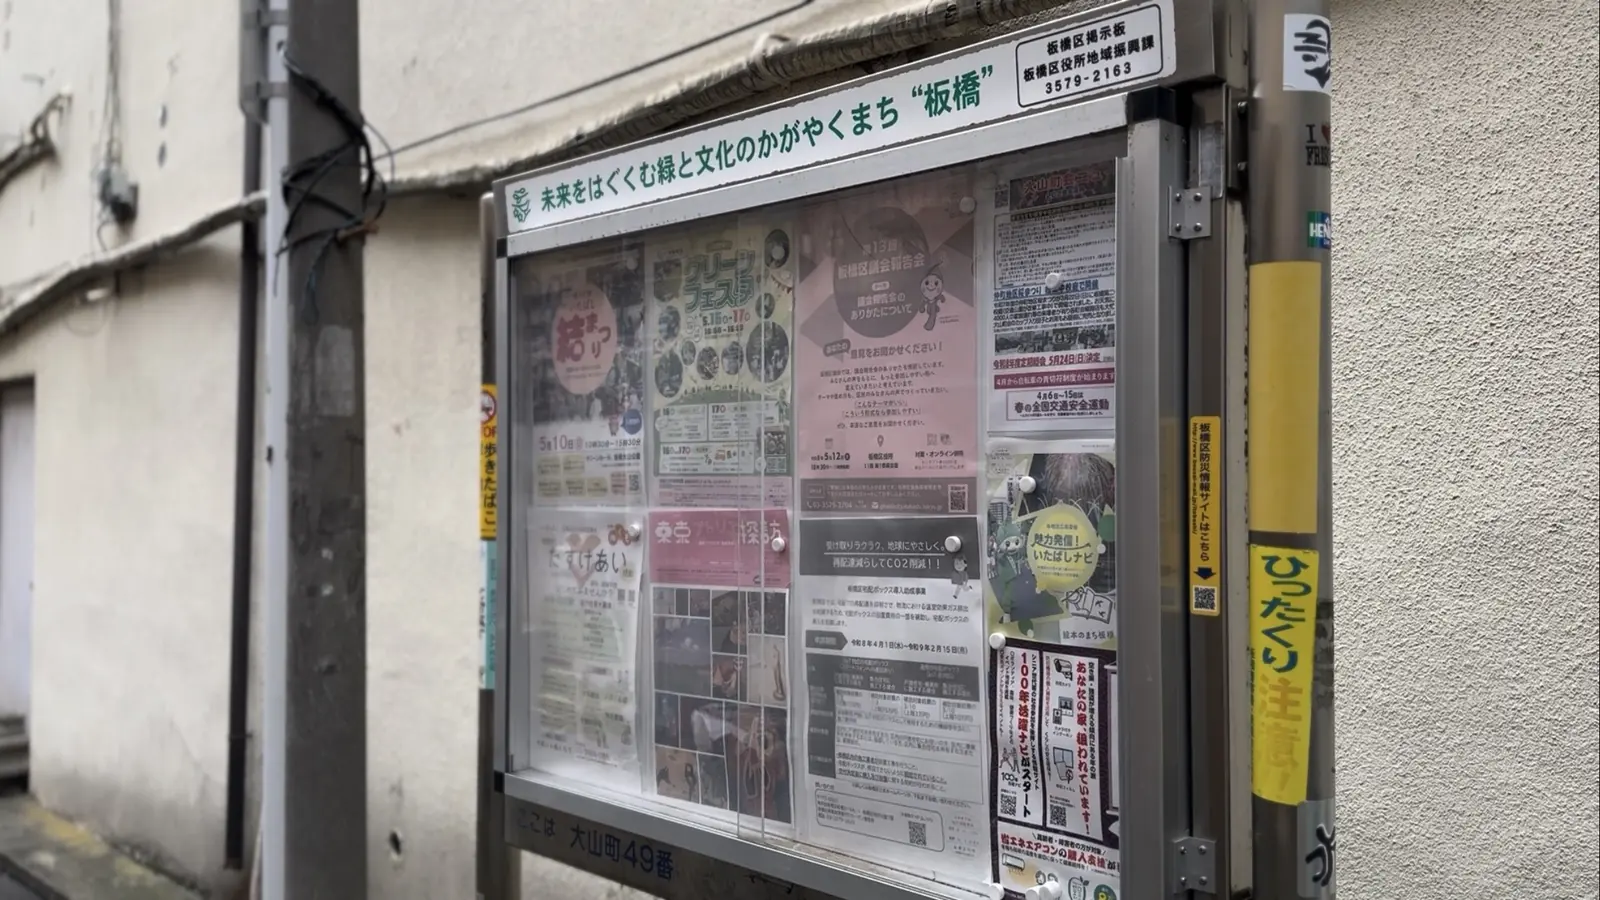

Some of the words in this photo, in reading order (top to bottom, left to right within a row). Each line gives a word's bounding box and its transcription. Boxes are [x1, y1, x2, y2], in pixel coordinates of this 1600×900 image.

[1023, 34, 1155, 82] 板橋区役所地域振興課
[1046, 21, 1127, 56] 板橋区掲示板
[1045, 62, 1132, 94] 3579-2163
[541, 95, 899, 212] 未来をはぐくむ緑と文化のかがやくまち
[1014, 398, 1110, 414] 春の全国交通安全運動
[1199, 422, 1211, 562] 板橋区防災情報サイトはこちら
[825, 539, 946, 552] 受け取りラクラク、地球にやさしく。
[1033, 550, 1094, 565] いたばしナビ
[1034, 532, 1079, 547] 魅力発信！
[1260, 555, 1312, 674] ひったくり
[1076, 661, 1091, 835] あなたの家、狙われています！
[570, 823, 674, 881] 大山町49番
